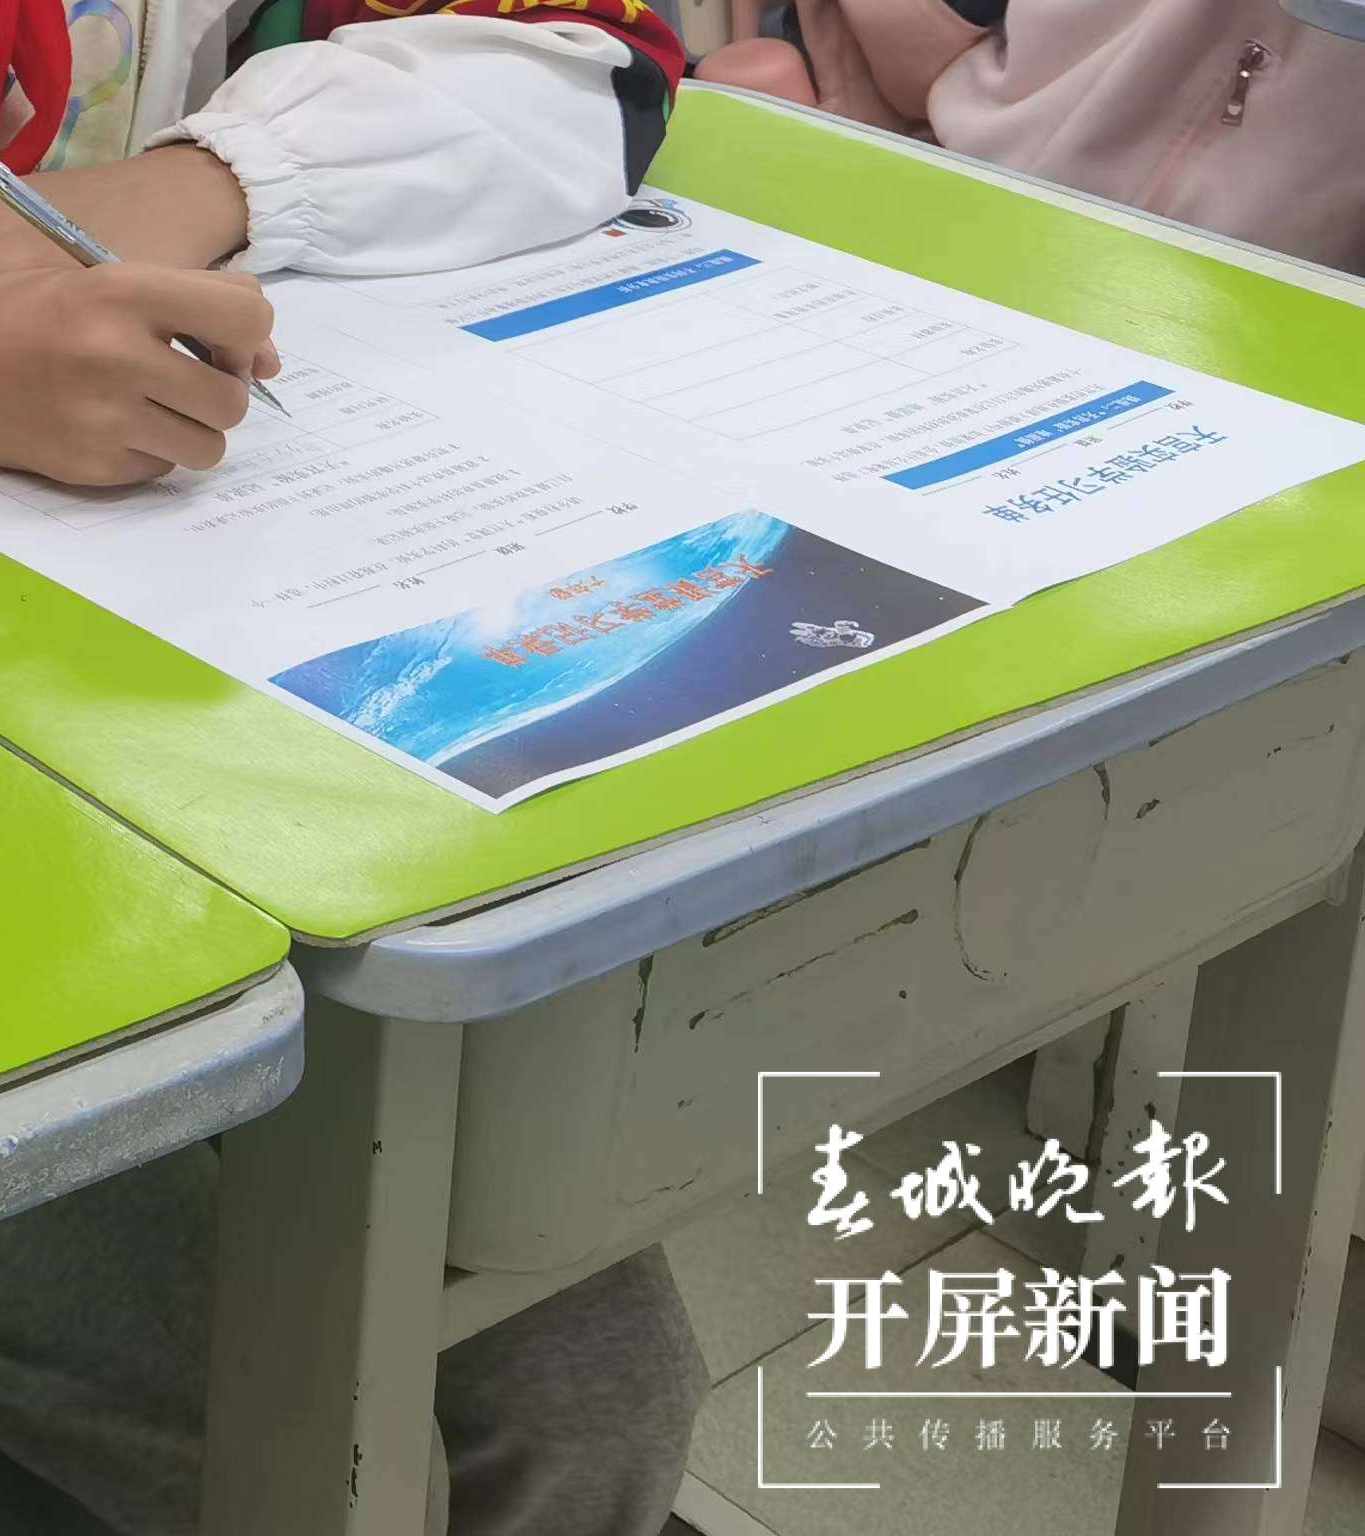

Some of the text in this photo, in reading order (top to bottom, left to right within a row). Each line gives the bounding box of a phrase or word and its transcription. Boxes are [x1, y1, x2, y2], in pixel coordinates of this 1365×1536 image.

[973, 424, 1233, 524] 天宫实验学习任务单
[473, 554, 781, 669] 天宫课堂学习记录单
